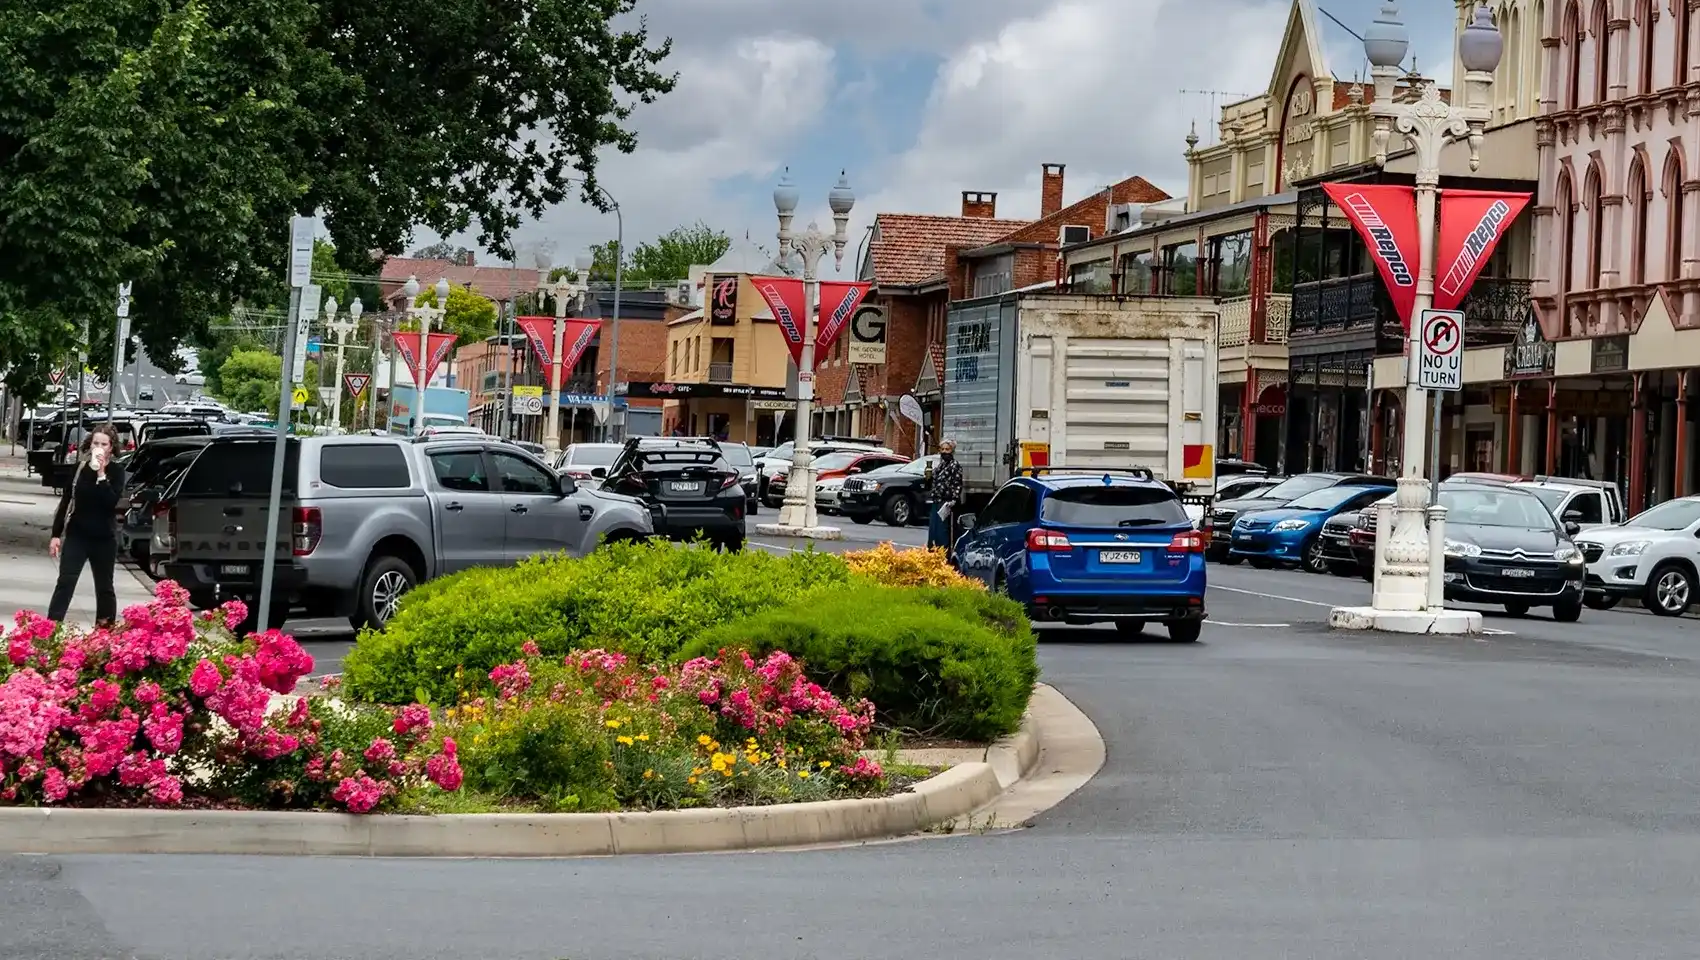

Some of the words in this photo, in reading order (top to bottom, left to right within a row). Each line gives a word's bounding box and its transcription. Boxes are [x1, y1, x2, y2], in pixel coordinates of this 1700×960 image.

[1464, 199, 1509, 260] Repco
[1370, 225, 1413, 286] Repco
[834, 287, 860, 324] Repco
[778, 306, 801, 343] Repco
[852, 307, 886, 343] G
[1423, 355, 1443, 369] NO
[1449, 356, 1459, 370] U
[1423, 371, 1456, 385] TURN
